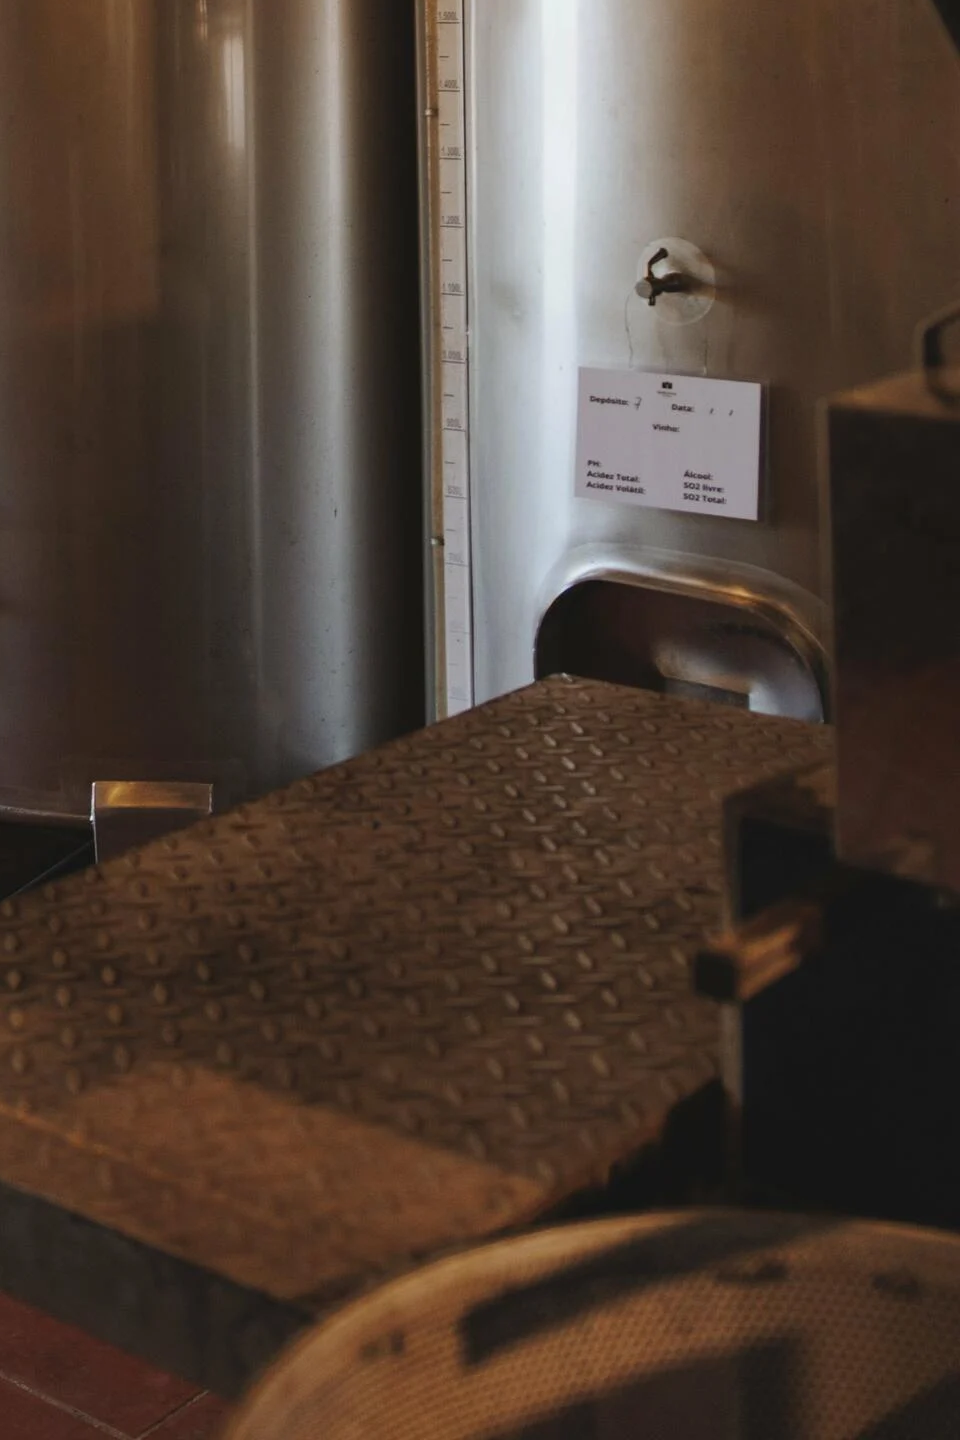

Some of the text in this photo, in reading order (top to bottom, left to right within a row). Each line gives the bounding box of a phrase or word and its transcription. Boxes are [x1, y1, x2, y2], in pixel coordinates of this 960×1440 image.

[671, 403, 695, 413] Data:
[652, 423, 680, 433] Vinho:
[586, 470, 640, 483] Acidez Total:
[586, 481, 614, 491] Acidez
[683, 482, 700, 491] SO2
[683, 492, 728, 505] SO2 Total:
